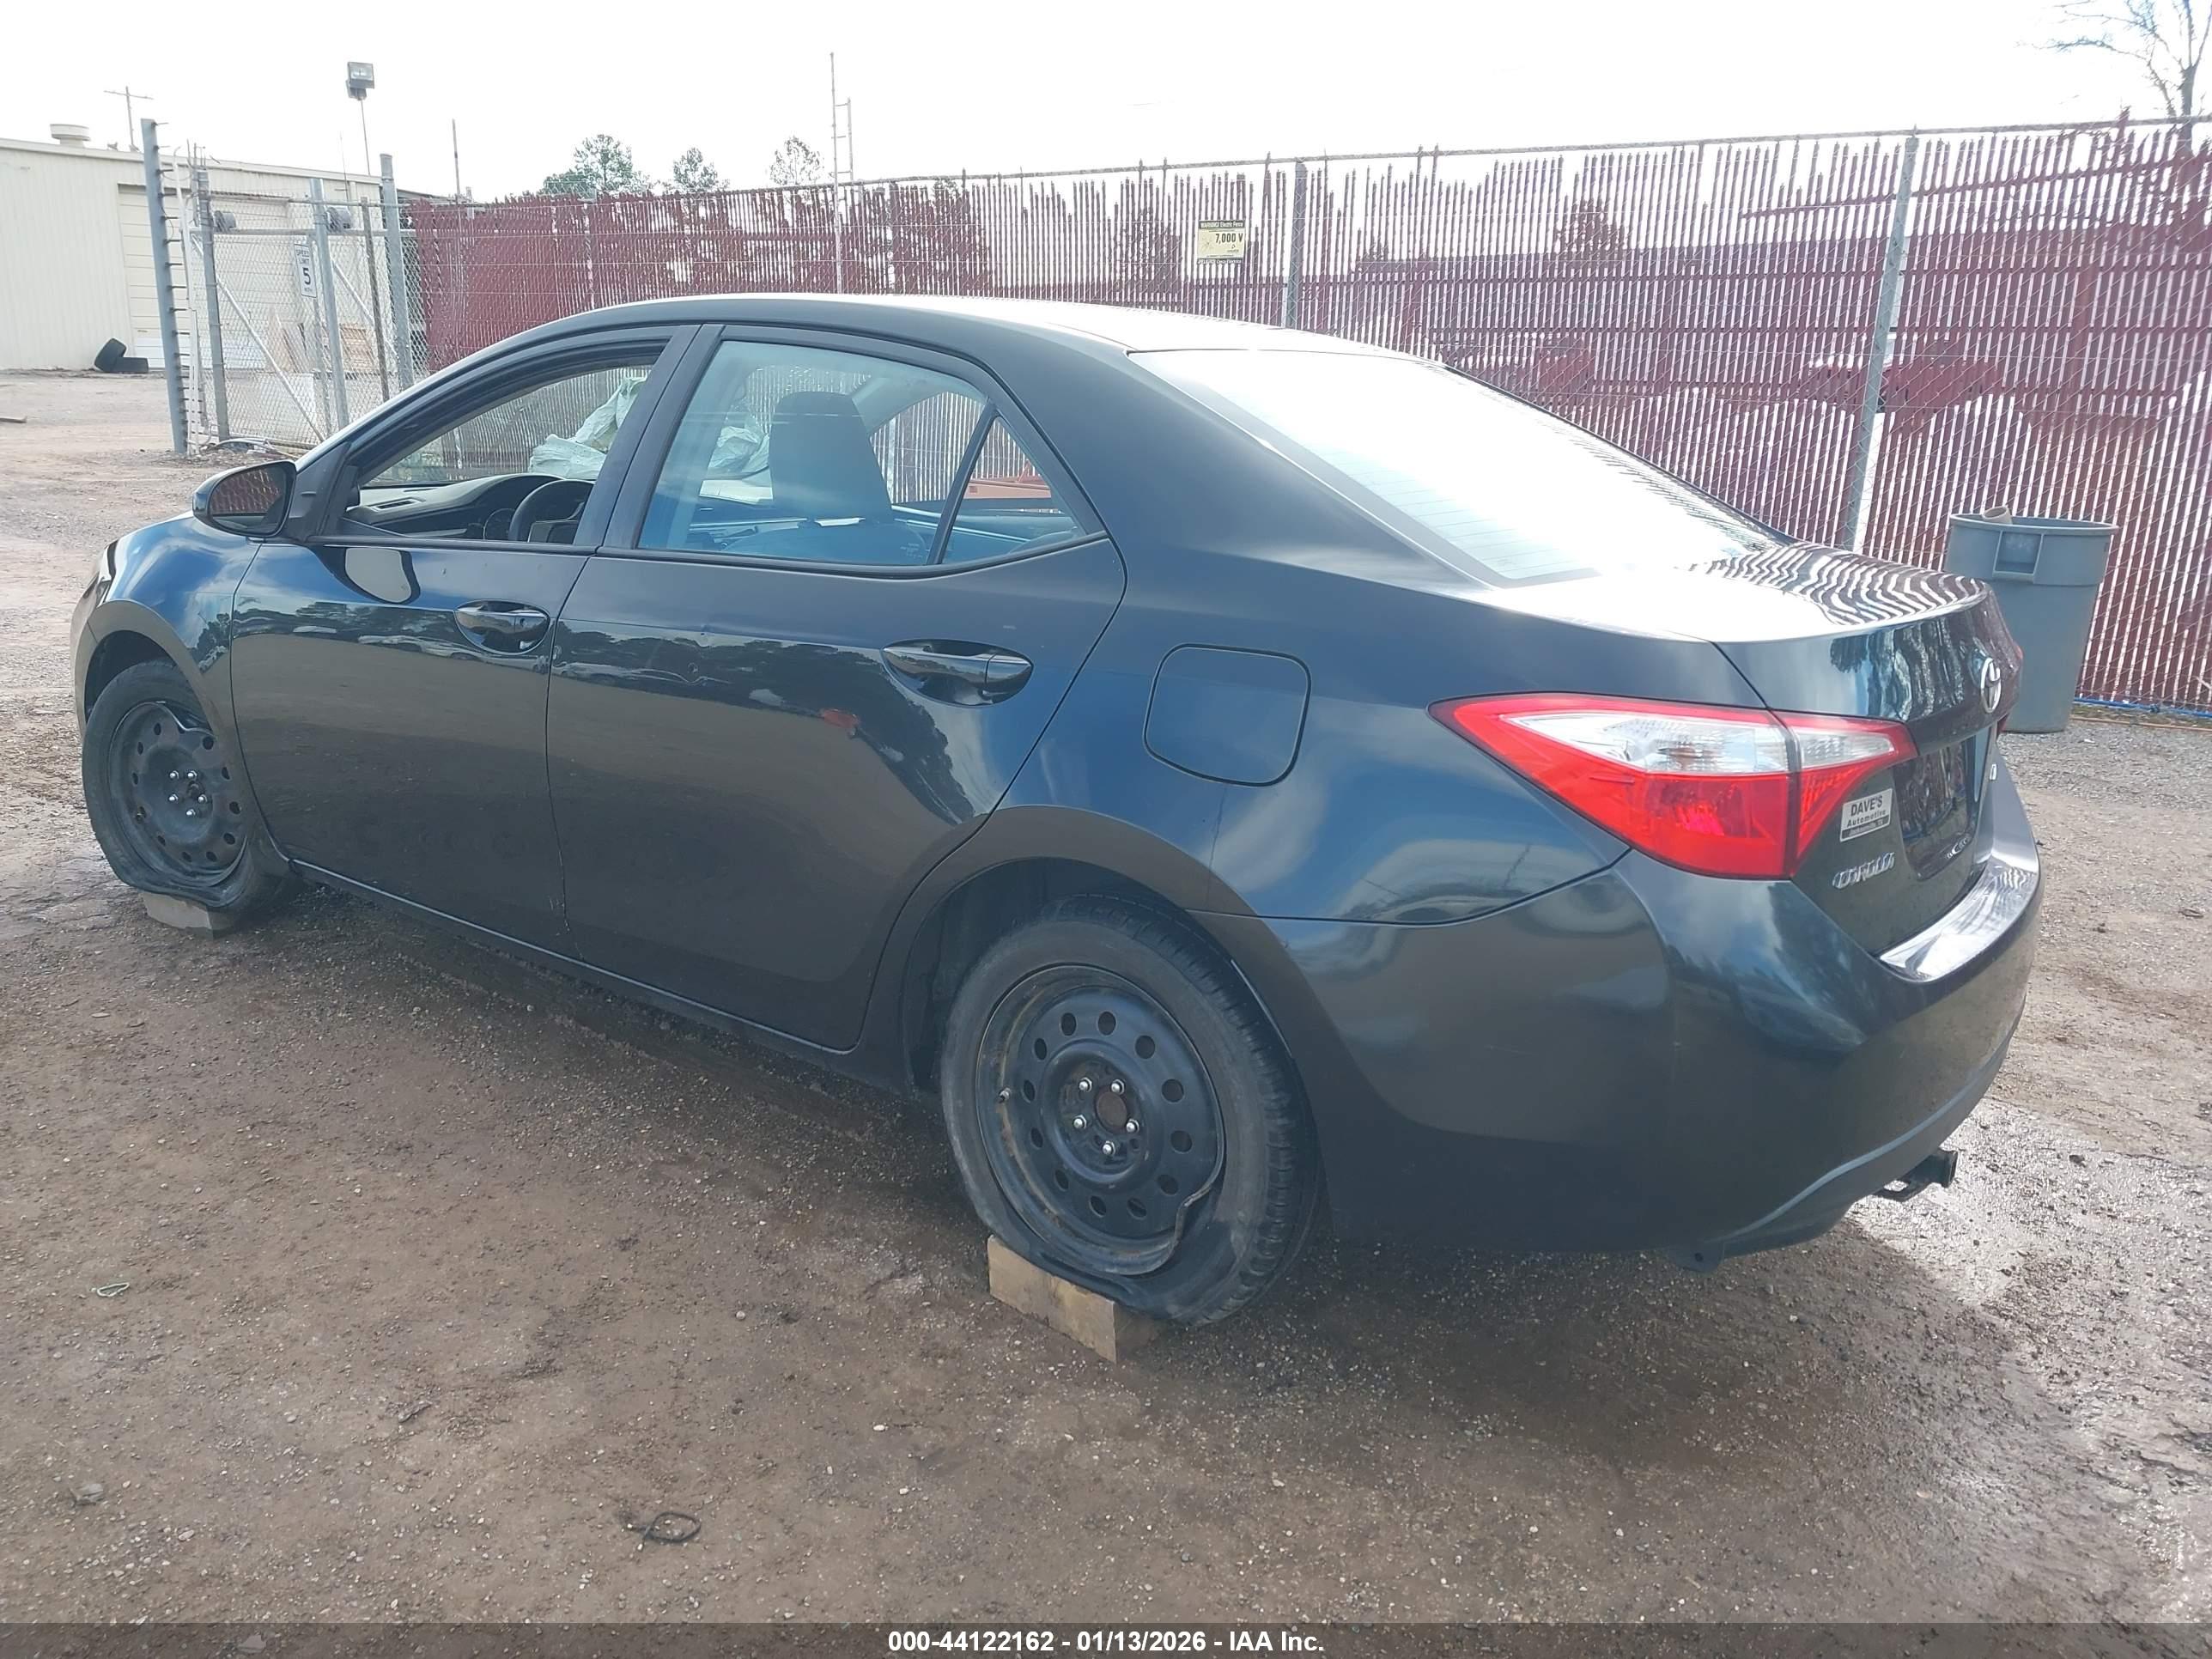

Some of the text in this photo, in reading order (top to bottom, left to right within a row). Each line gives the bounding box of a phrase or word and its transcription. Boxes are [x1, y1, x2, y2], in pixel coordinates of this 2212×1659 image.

[1215, 233, 1243, 245] 7,000 V
[302, 267, 311, 285] 5
[1850, 795, 1883, 817] DAVE'S
[1846, 809, 1887, 828] Automotive
[1832, 852, 1895, 889] COROLLA
